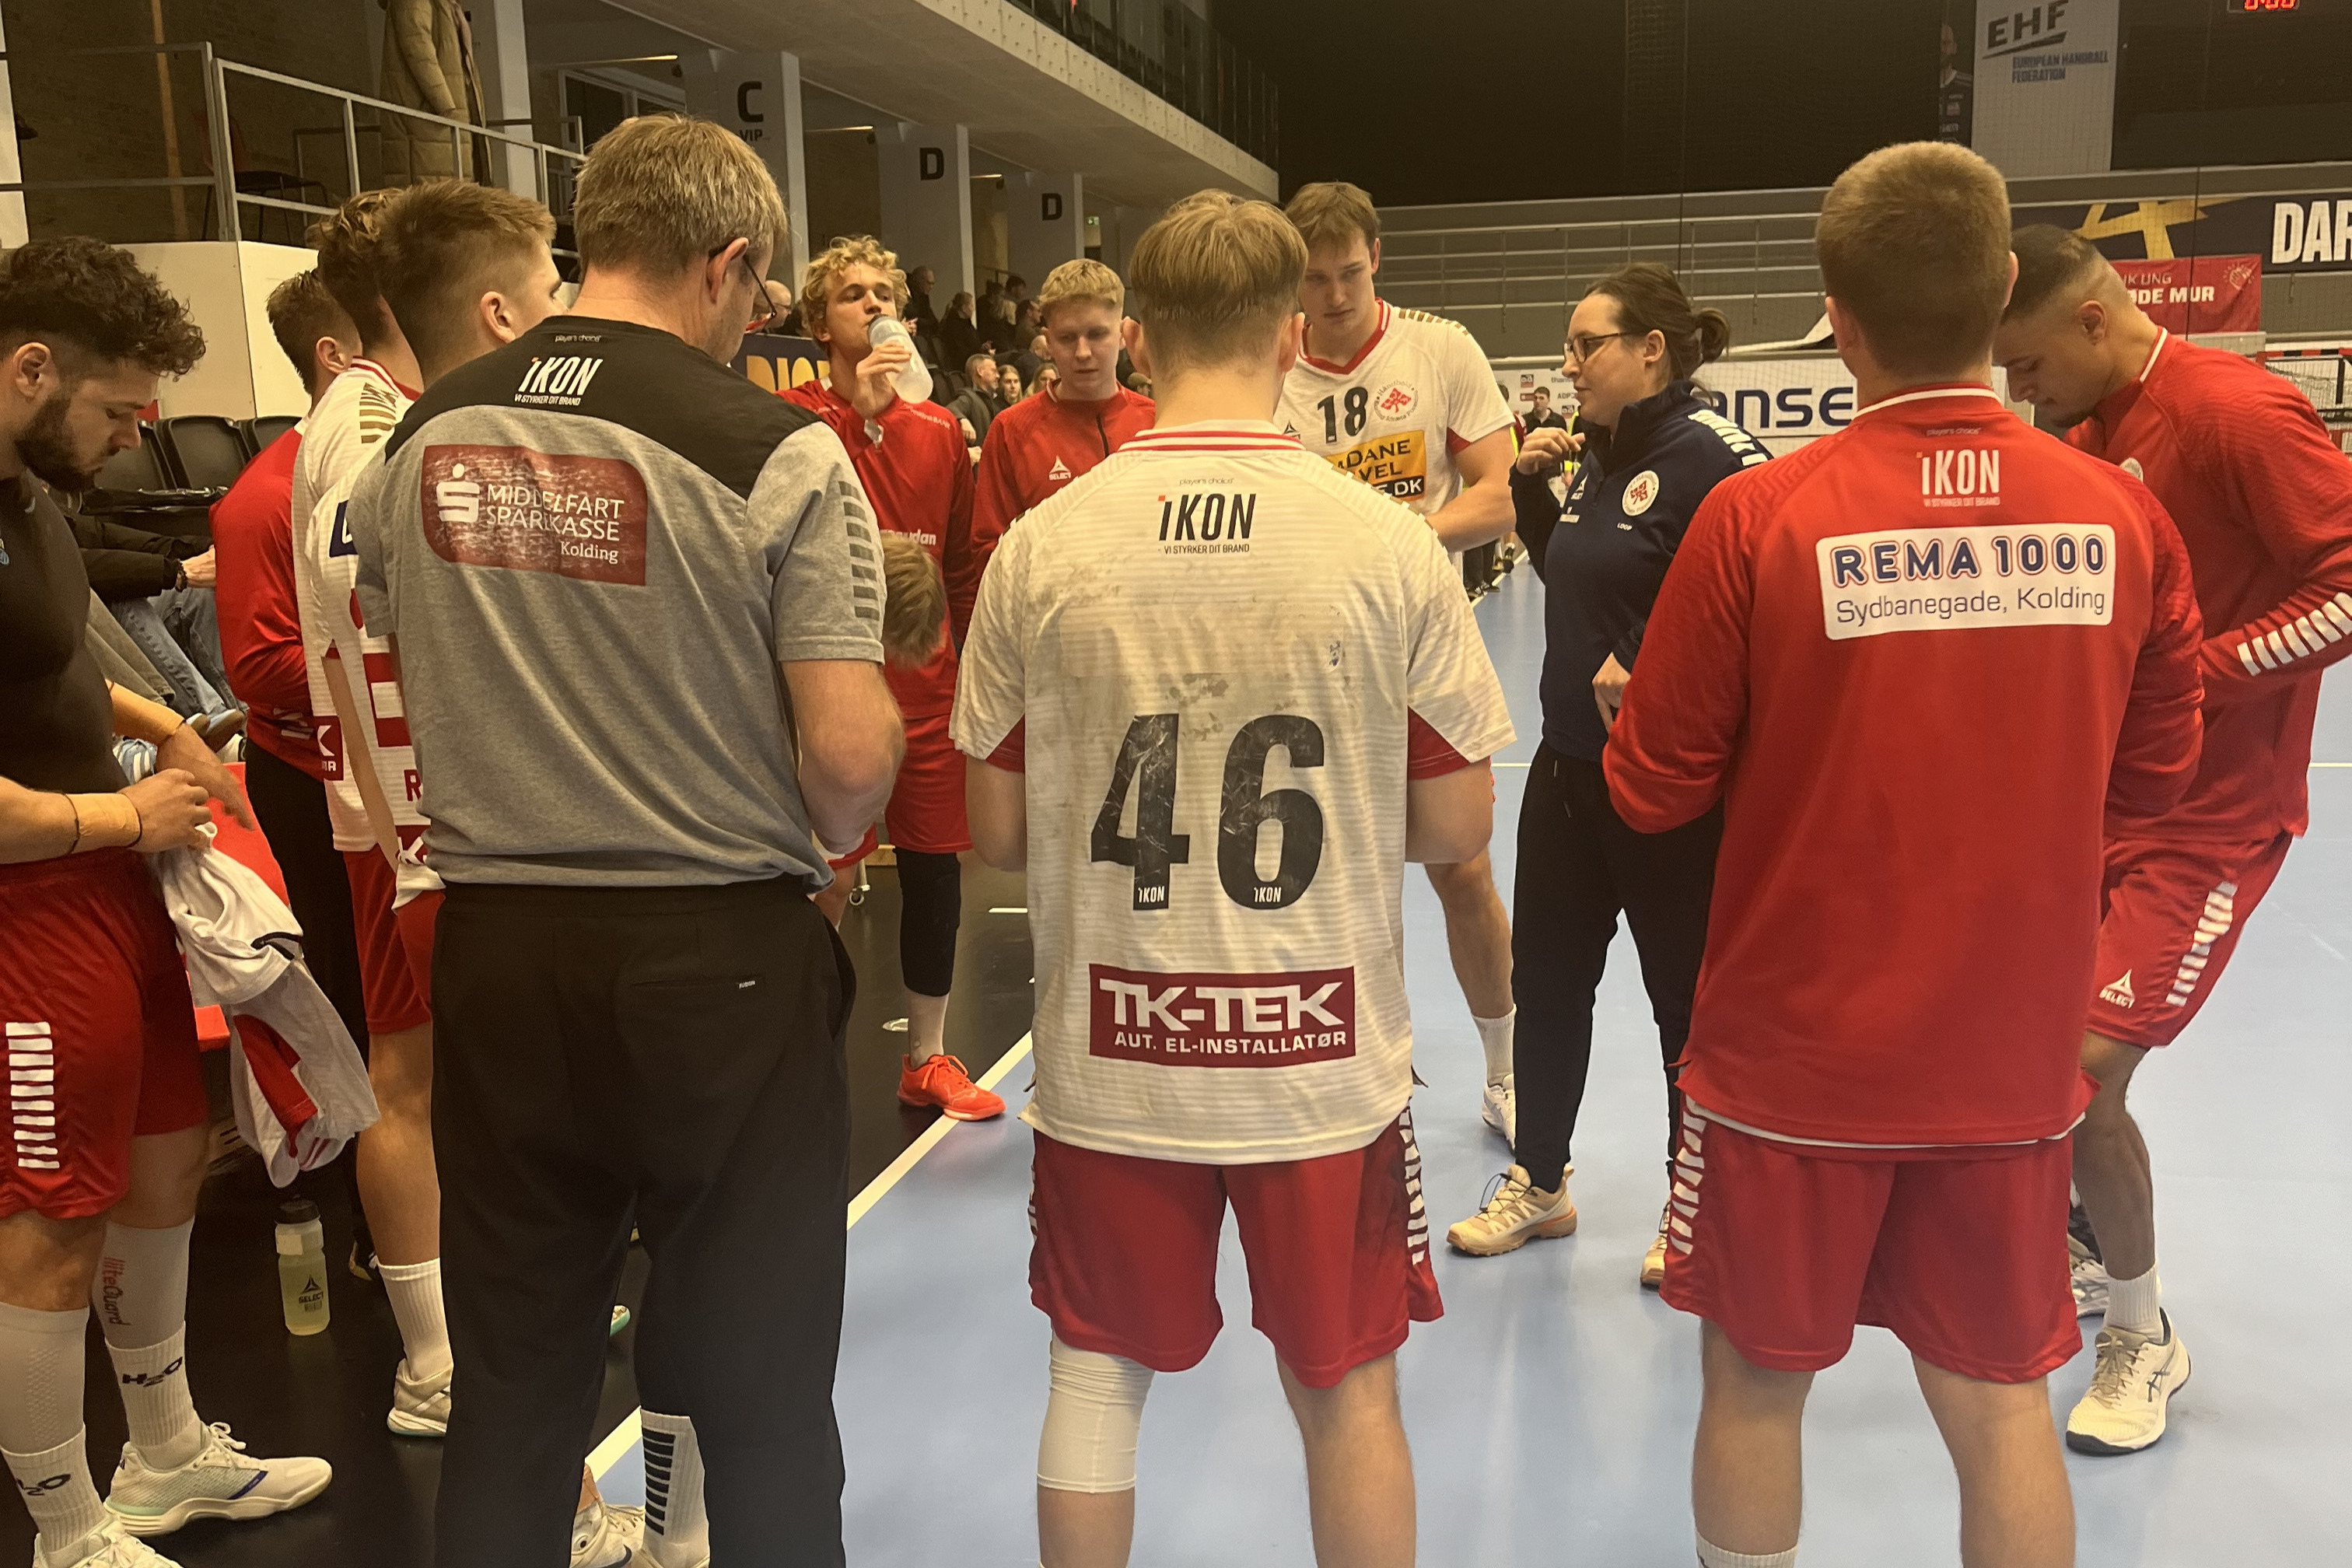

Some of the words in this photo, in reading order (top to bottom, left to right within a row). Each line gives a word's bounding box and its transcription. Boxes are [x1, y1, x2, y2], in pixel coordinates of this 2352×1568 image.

[1987, 0, 2068, 50] EHF
[737, 81, 764, 123] C
[739, 129, 763, 142] VIP
[919, 147, 944, 180] D
[1041, 193, 1062, 221] D
[2140, 272, 2172, 285] UNG
[2169, 286, 2214, 303] MUR
[521, 394, 548, 404] STYRKER
[548, 396, 559, 404] DIT
[558, 397, 581, 406] BRAND
[1318, 387, 1368, 443] 18
[561, 541, 619, 563] Kolding
[1164, 545, 1171, 555] VI
[1173, 545, 1207, 555] STYRKER
[1209, 544, 1221, 554] DIT
[1223, 544, 1250, 553] BRAND
[1830, 537, 1982, 588] REMA
[1992, 533, 2107, 577] 1000
[1837, 589, 2007, 627] Sydbanegade,
[2018, 586, 2105, 614] Kolding
[1090, 713, 1325, 910] 46
[1099, 978, 1345, 1033] TK-TEK
[1115, 1031, 1157, 1050] AUT.
[1167, 1031, 1346, 1055] EL-INSTALLATØR
